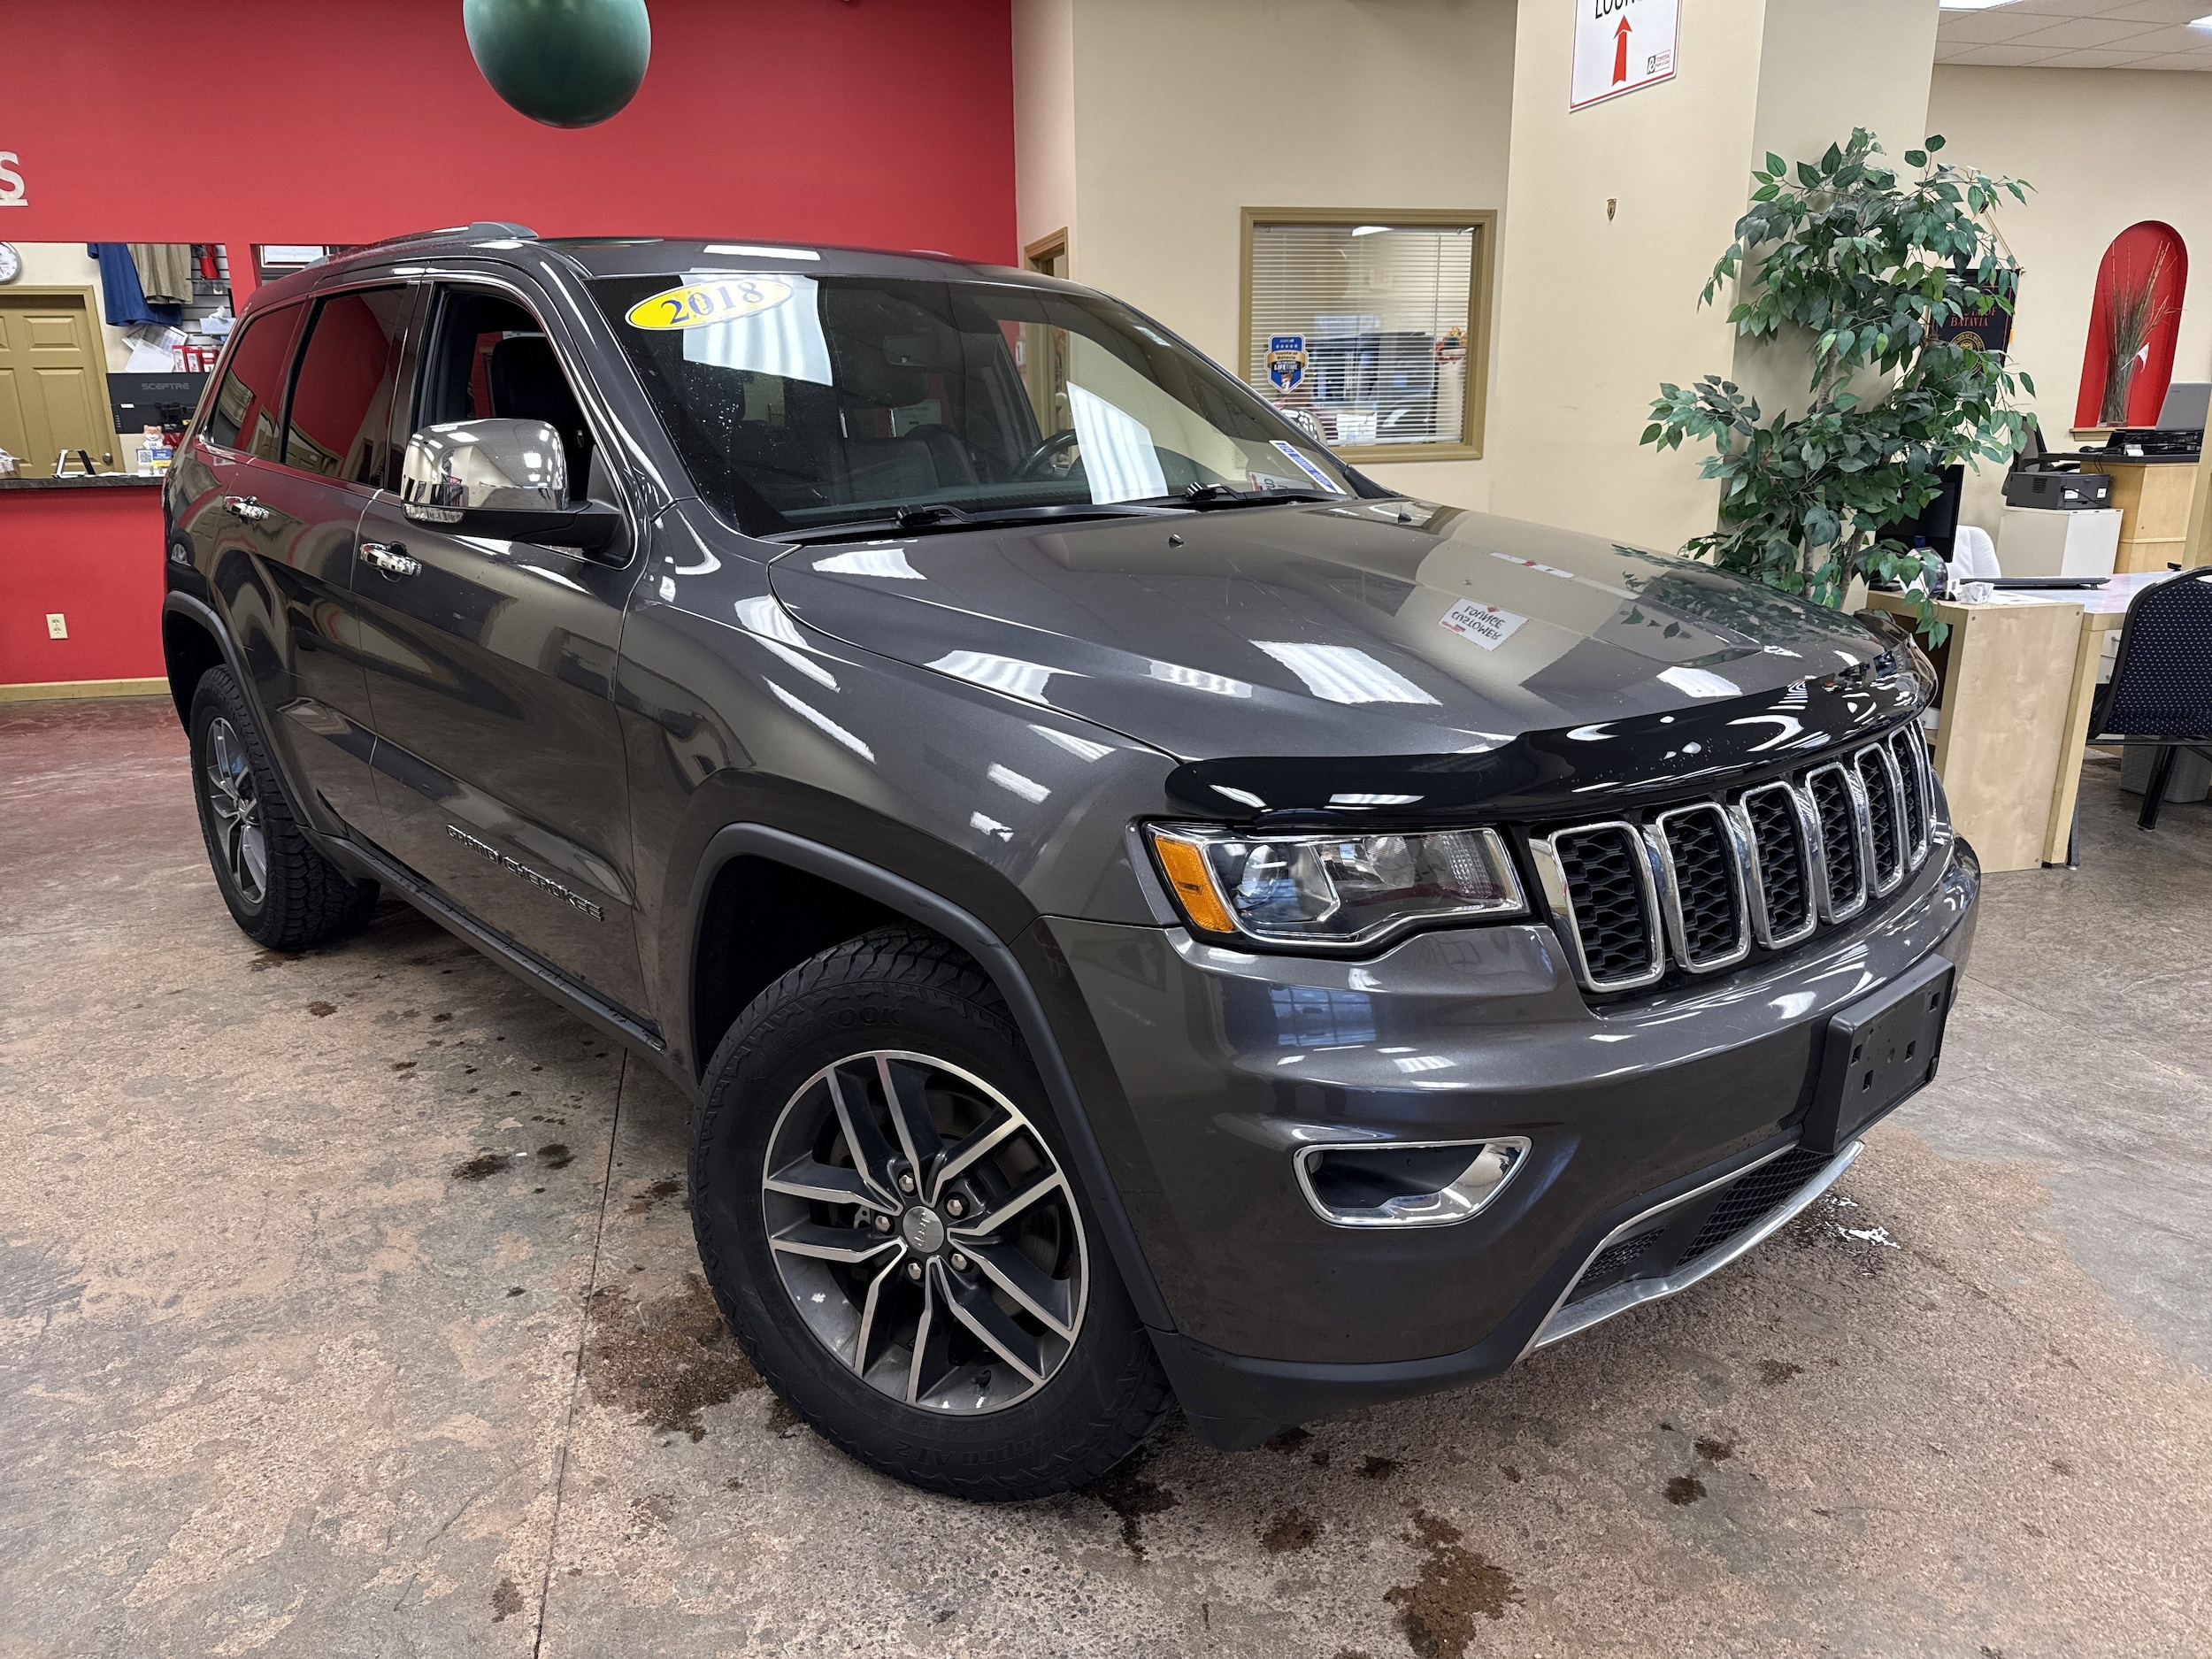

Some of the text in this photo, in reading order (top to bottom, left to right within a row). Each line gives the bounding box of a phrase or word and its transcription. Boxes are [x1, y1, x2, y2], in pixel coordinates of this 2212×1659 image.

[661, 281, 764, 324] 2018
[1950, 317, 1988, 326] BATAVIA
[446, 824, 502, 864] GRAND
[503, 856, 605, 922] CHEROKEE
[912, 1210, 932, 1248] Jeep
